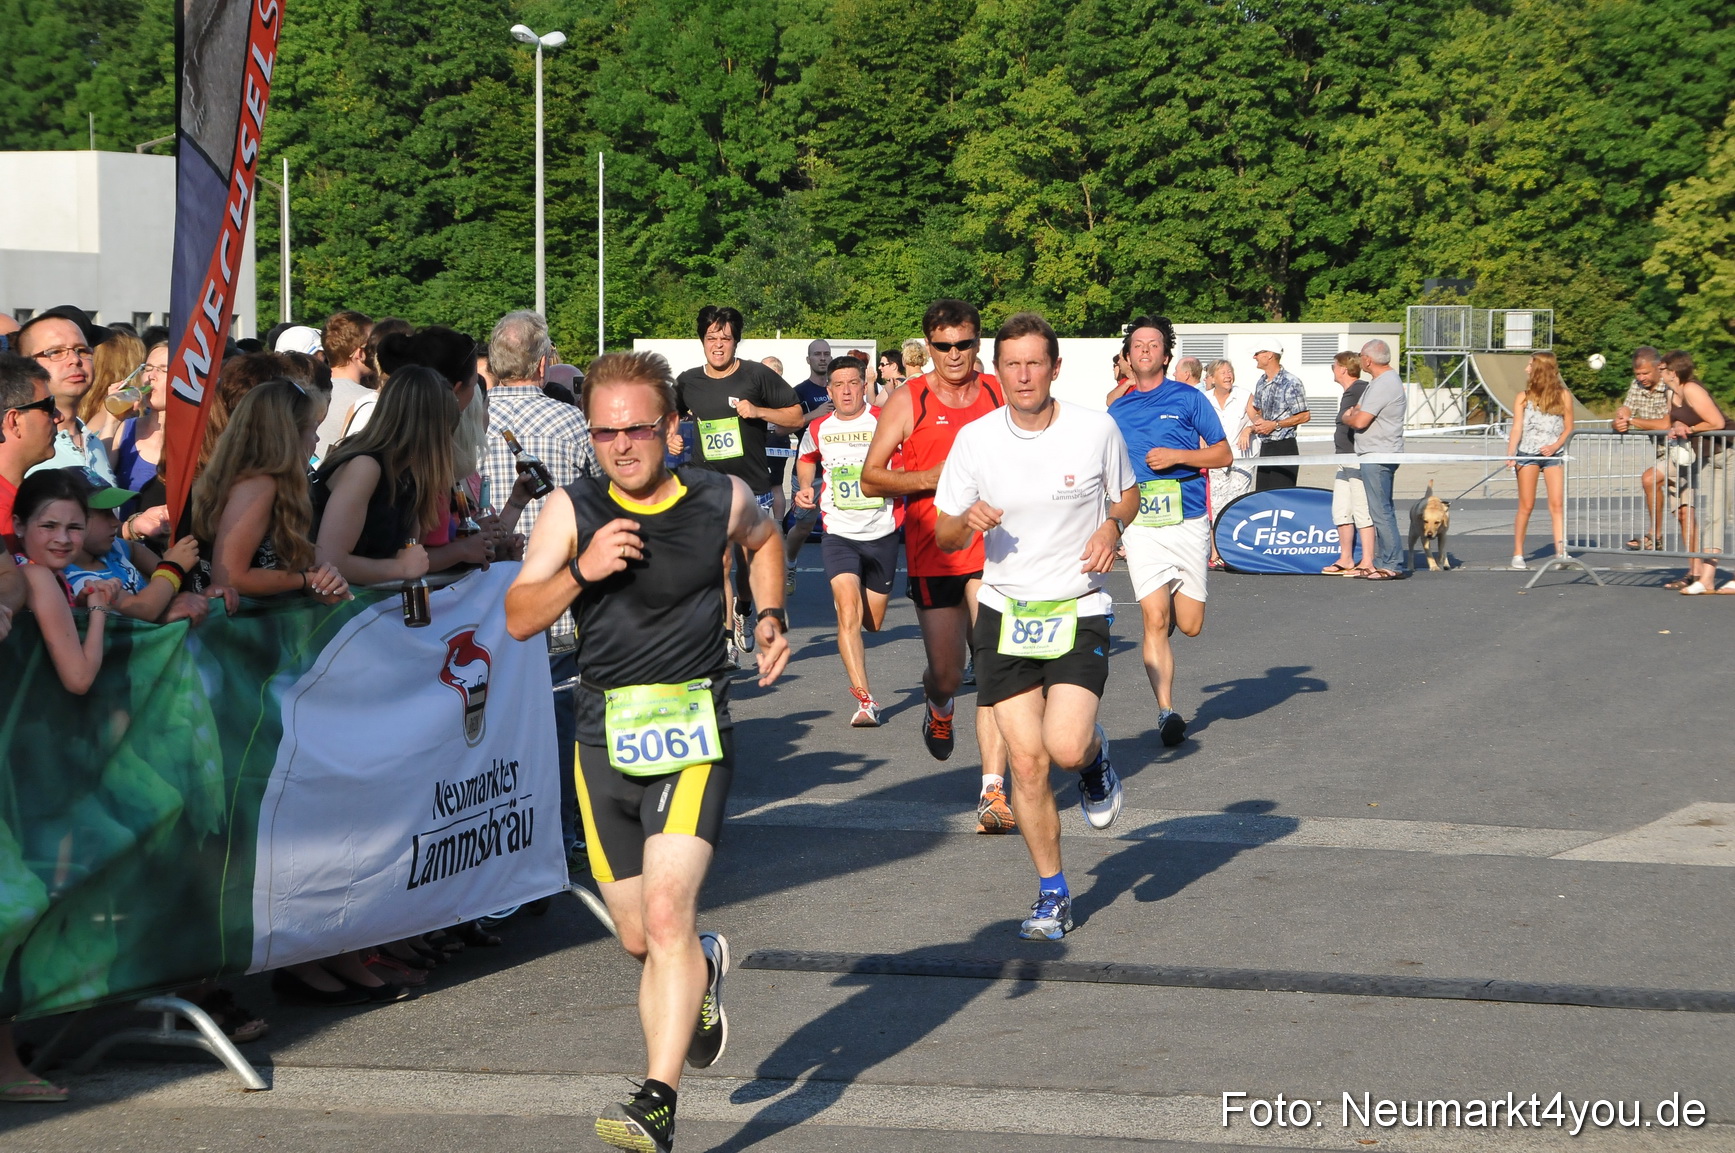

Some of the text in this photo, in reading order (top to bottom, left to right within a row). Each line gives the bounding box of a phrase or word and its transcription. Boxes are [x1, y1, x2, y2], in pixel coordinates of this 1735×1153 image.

[705, 432, 734, 450] 266
[824, 432, 868, 442] ONLINE
[838, 480, 860, 499] 91
[1139, 495, 1171, 515] 841
[1011, 617, 1063, 645] 897
[616, 725, 710, 764] 5061
[432, 758, 519, 820] Neumarkter
[406, 798, 534, 891] Lammsbräu
